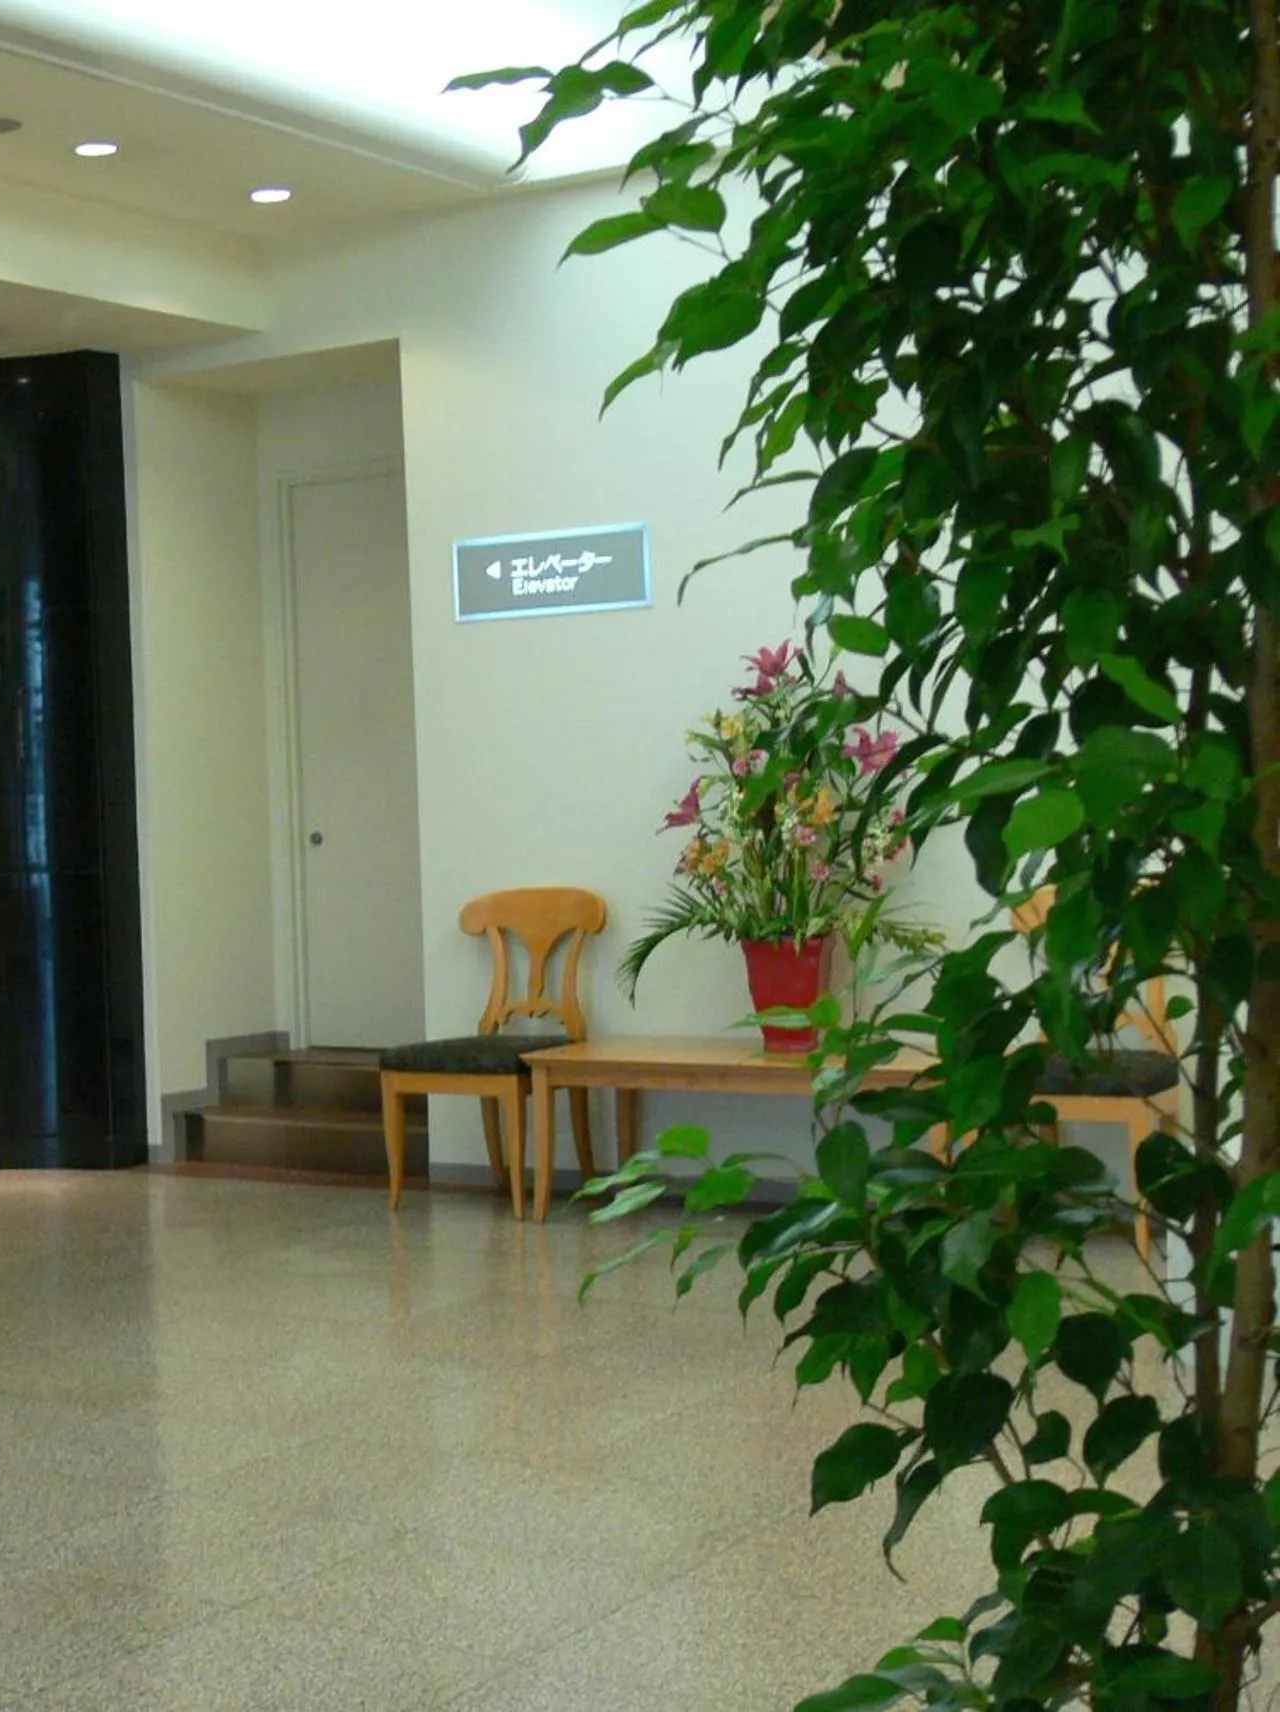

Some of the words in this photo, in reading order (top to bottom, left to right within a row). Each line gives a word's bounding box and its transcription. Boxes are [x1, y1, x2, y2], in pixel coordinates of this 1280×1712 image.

[510, 550, 613, 579] エレベーター
[511, 576, 580, 596] Elevator
